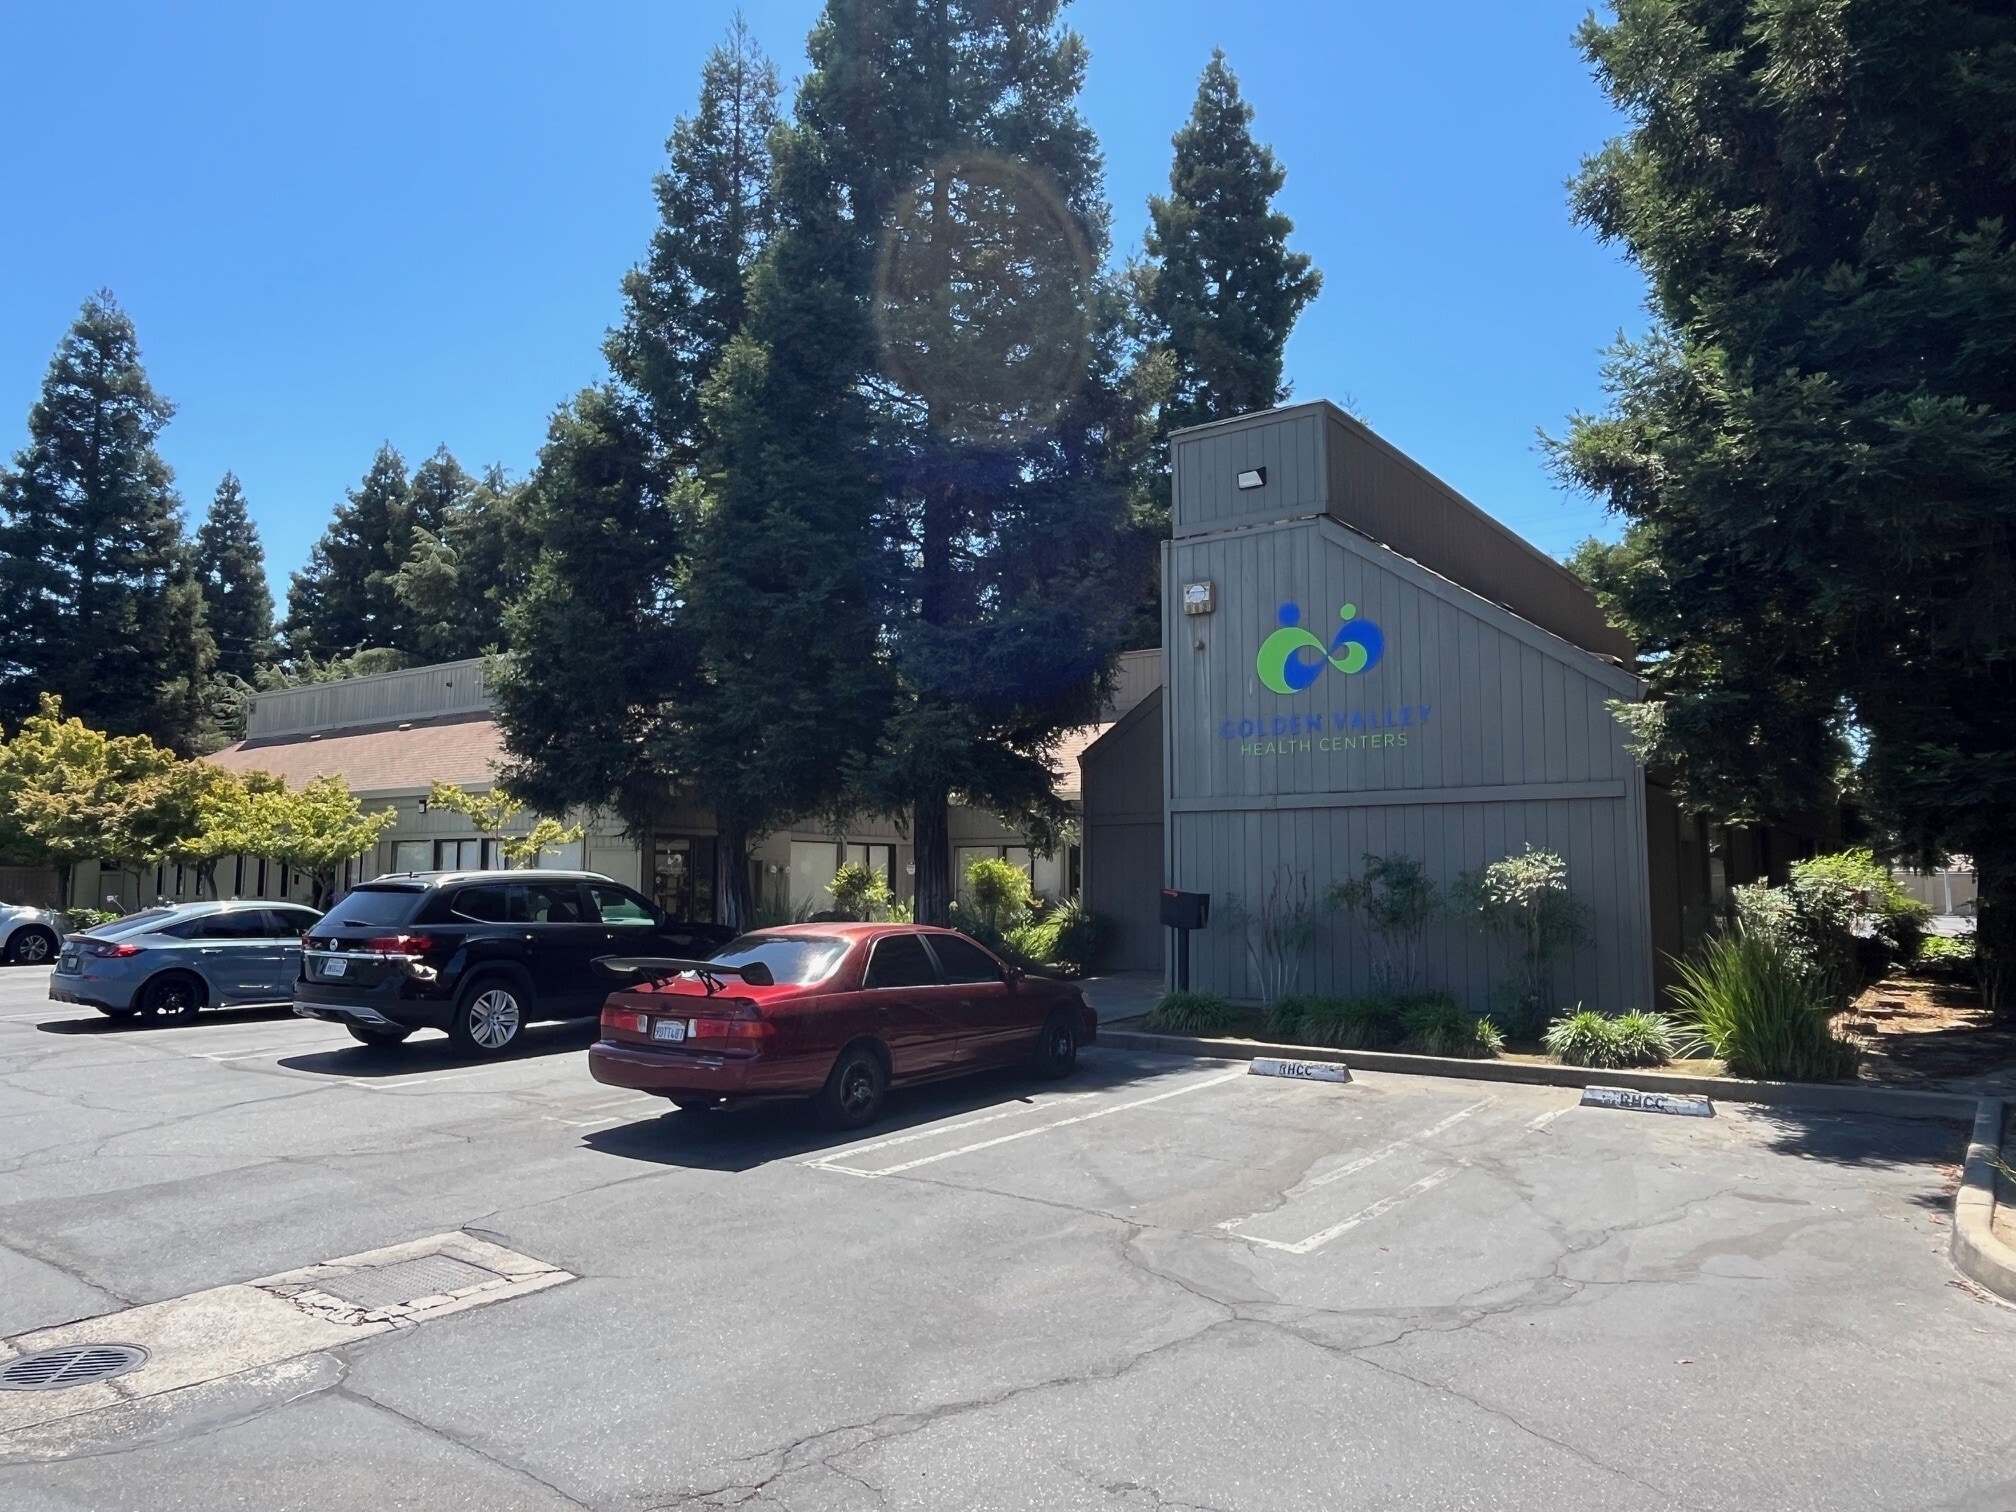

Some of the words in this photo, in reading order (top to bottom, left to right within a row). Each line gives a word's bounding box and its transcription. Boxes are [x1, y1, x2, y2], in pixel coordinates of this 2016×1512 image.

[1218, 712, 1323, 739] GOLDEN
[1333, 704, 1432, 731] VALLEY
[1241, 738, 1311, 756] HEALTH
[1319, 733, 1408, 751] CENTERS
